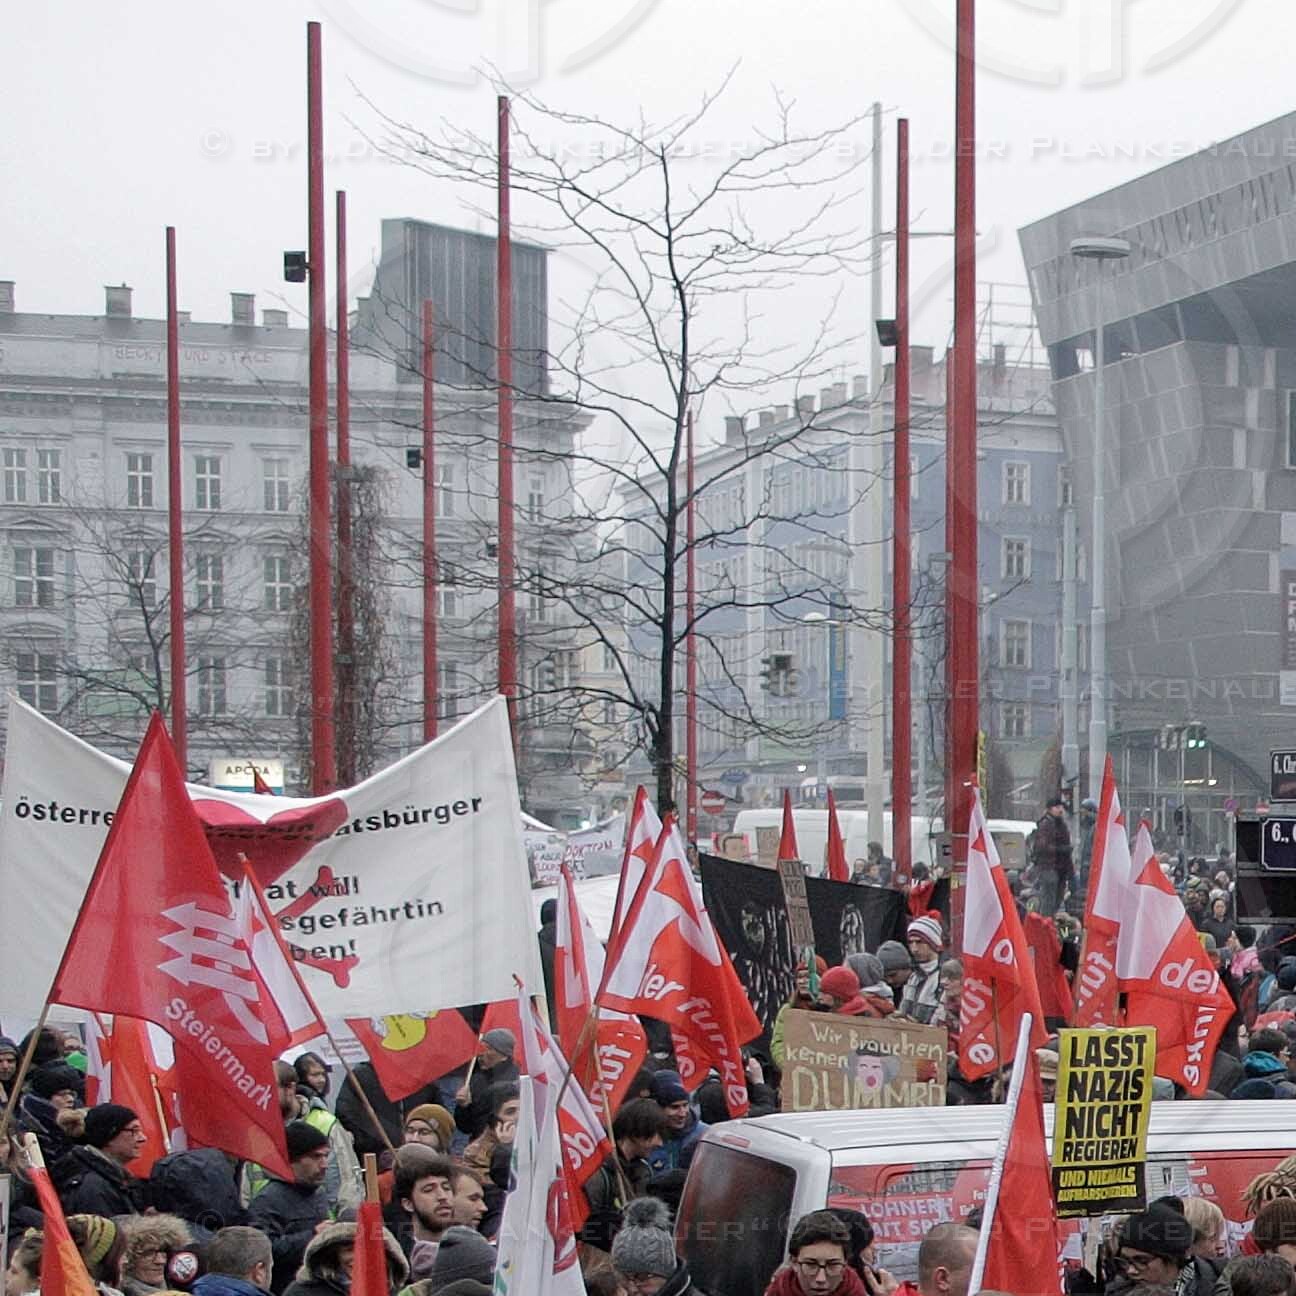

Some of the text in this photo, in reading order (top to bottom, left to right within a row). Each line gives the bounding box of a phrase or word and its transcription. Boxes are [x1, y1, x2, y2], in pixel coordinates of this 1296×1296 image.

[15, 796, 116, 827] österre
[1271, 823, 1289, 843] 6.,
[309, 875, 360, 899] will
[279, 898, 444, 935] sgefährtin
[289, 938, 358, 961] ben!
[165, 997, 272, 1111] Steiermark
[785, 1044, 852, 1070] keinen
[810, 1021, 944, 1063] Wir Brauchen
[1069, 1034, 1147, 1068] LASST
[1067, 1068, 1145, 1103] NAZIS
[1065, 1103, 1142, 1139] NICHT
[1062, 1137, 1138, 1163] REGIEREN
[1059, 1166, 1136, 1187] UND NIEMALS
